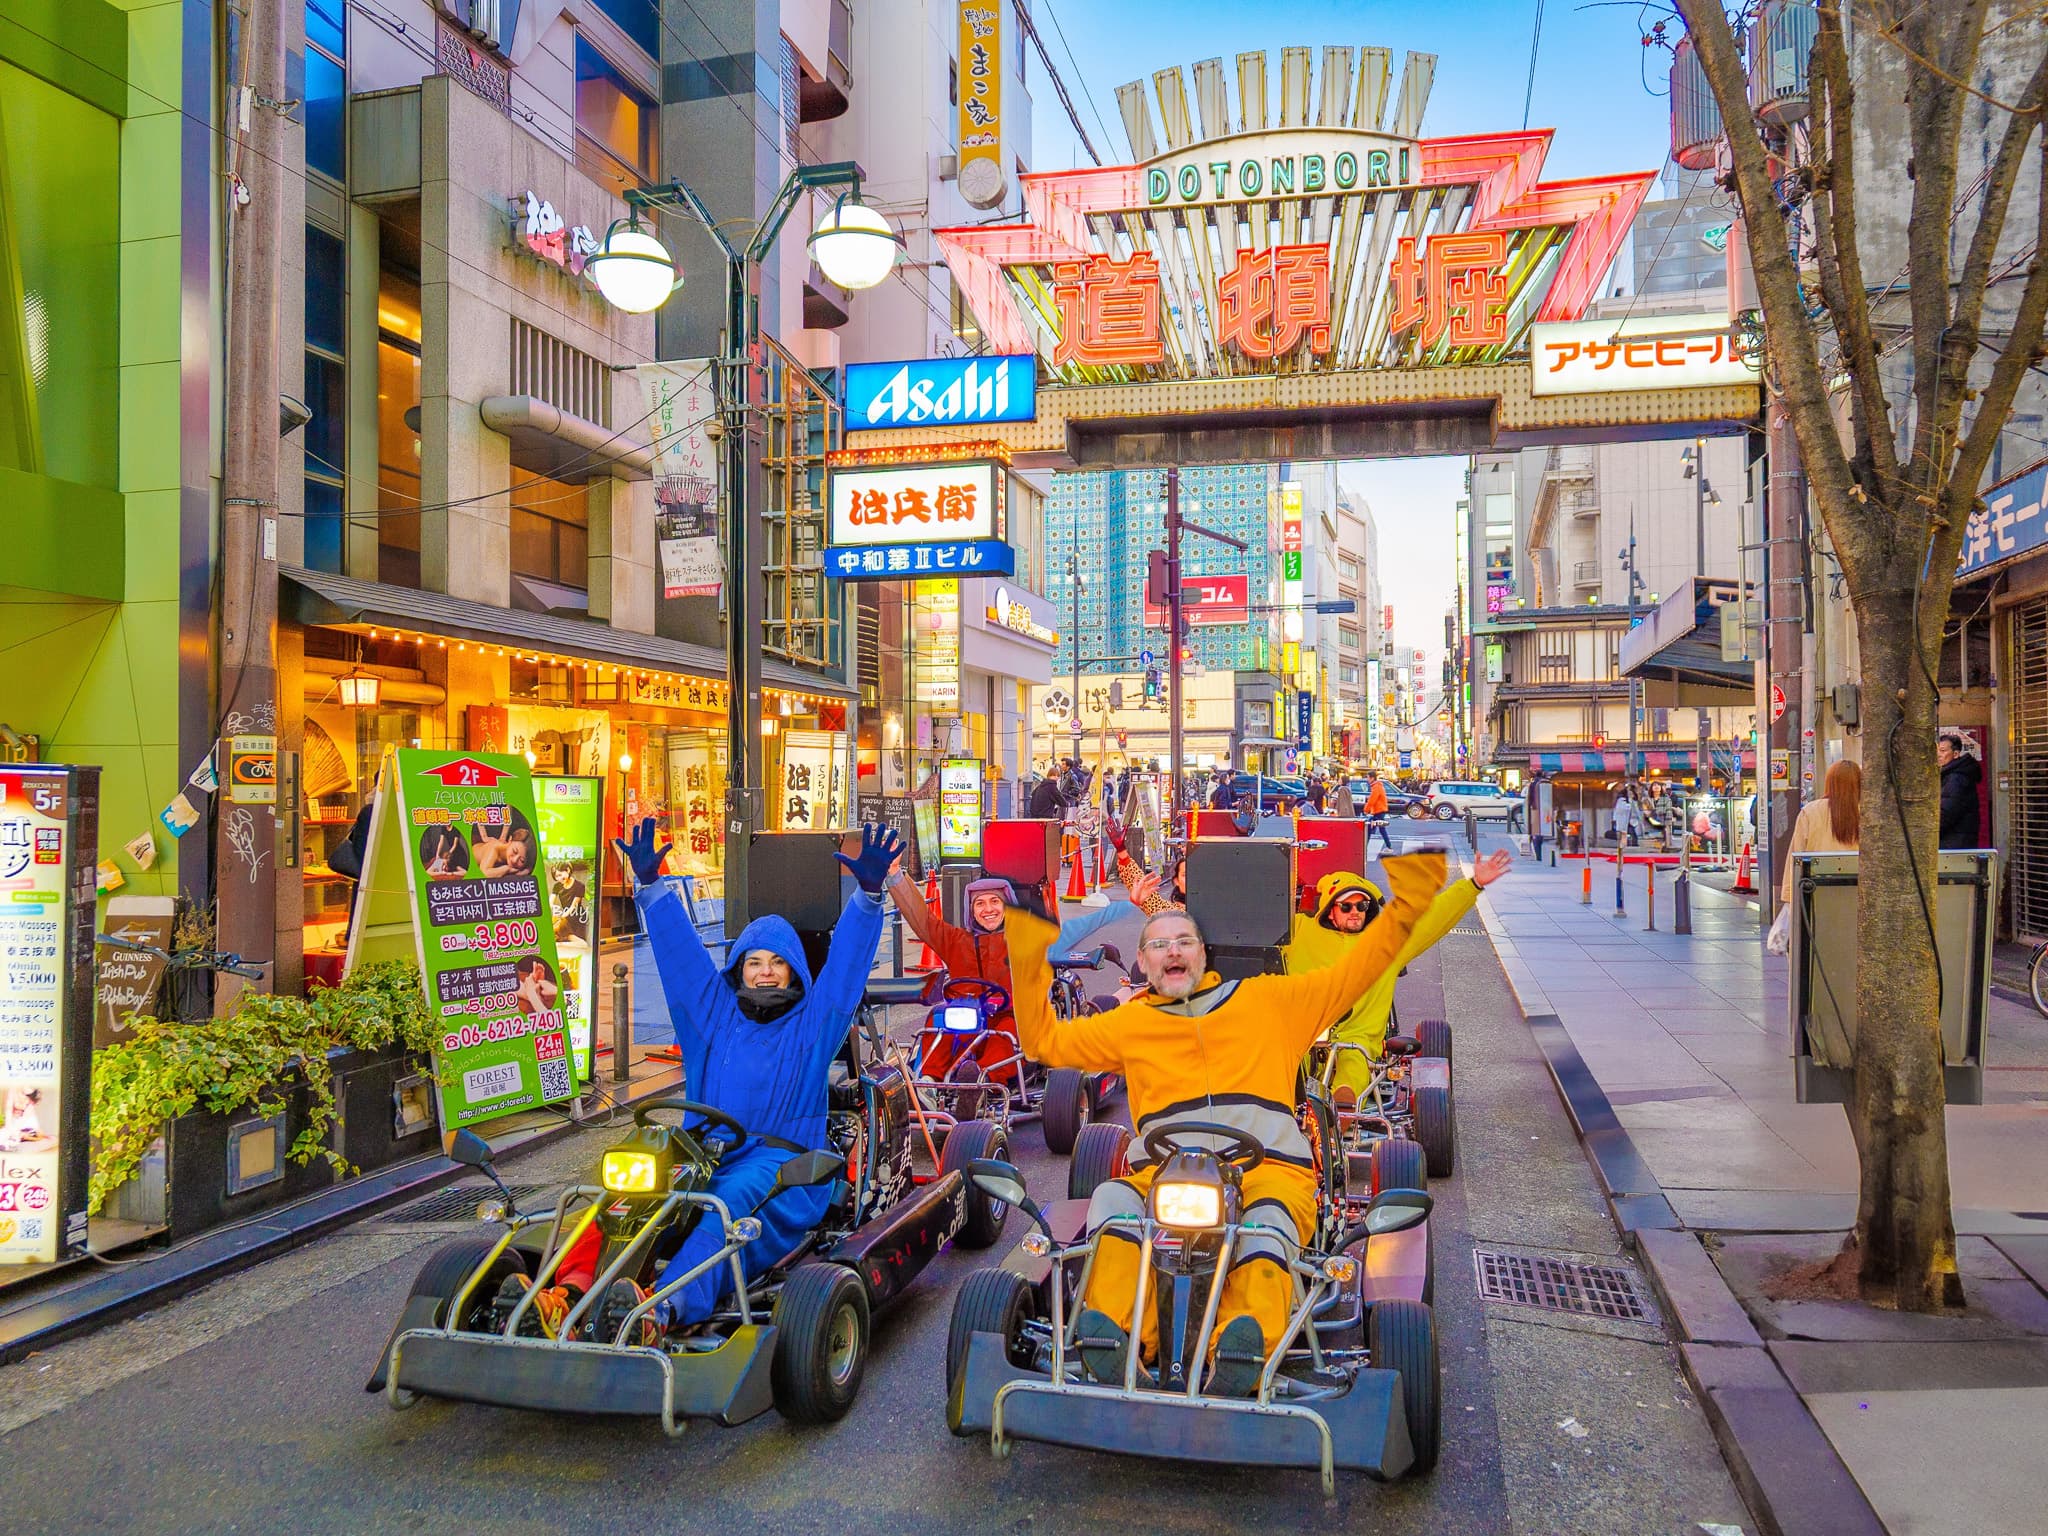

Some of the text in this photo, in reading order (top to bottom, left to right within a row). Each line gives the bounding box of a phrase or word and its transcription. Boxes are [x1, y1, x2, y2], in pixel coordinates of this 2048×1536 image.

[966, 43, 997, 126] まこ家
[1147, 147, 1412, 204] DOTONBORI
[1054, 230, 1508, 366] 道頓堀
[866, 358, 1009, 424] Asahi
[849, 483, 977, 526] 治兵衛
[932, 687, 956, 696] KARIN
[459, 765, 480, 785] 2F
[34, 789, 62, 811] 5F
[431, 884, 483, 901] もみほぐし
[488, 881, 536, 896] MASSAGE
[436, 904, 484, 922] 본격 마사지
[493, 901, 538, 917] 正宗按摩
[468, 920, 538, 952] ¥3,800
[112, 951, 153, 961] GUINNESS
[476, 967, 490, 979] FOOT
[452, 984, 474, 999] 마사지
[464, 992, 518, 1014] ¥5,000
[460, 1010, 564, 1047] 06-6212-7401
[536, 1034, 563, 1052] 24H
[469, 1066, 516, 1087] FOREST
[458, 1094, 534, 1120] http://www.d-forest.jp
